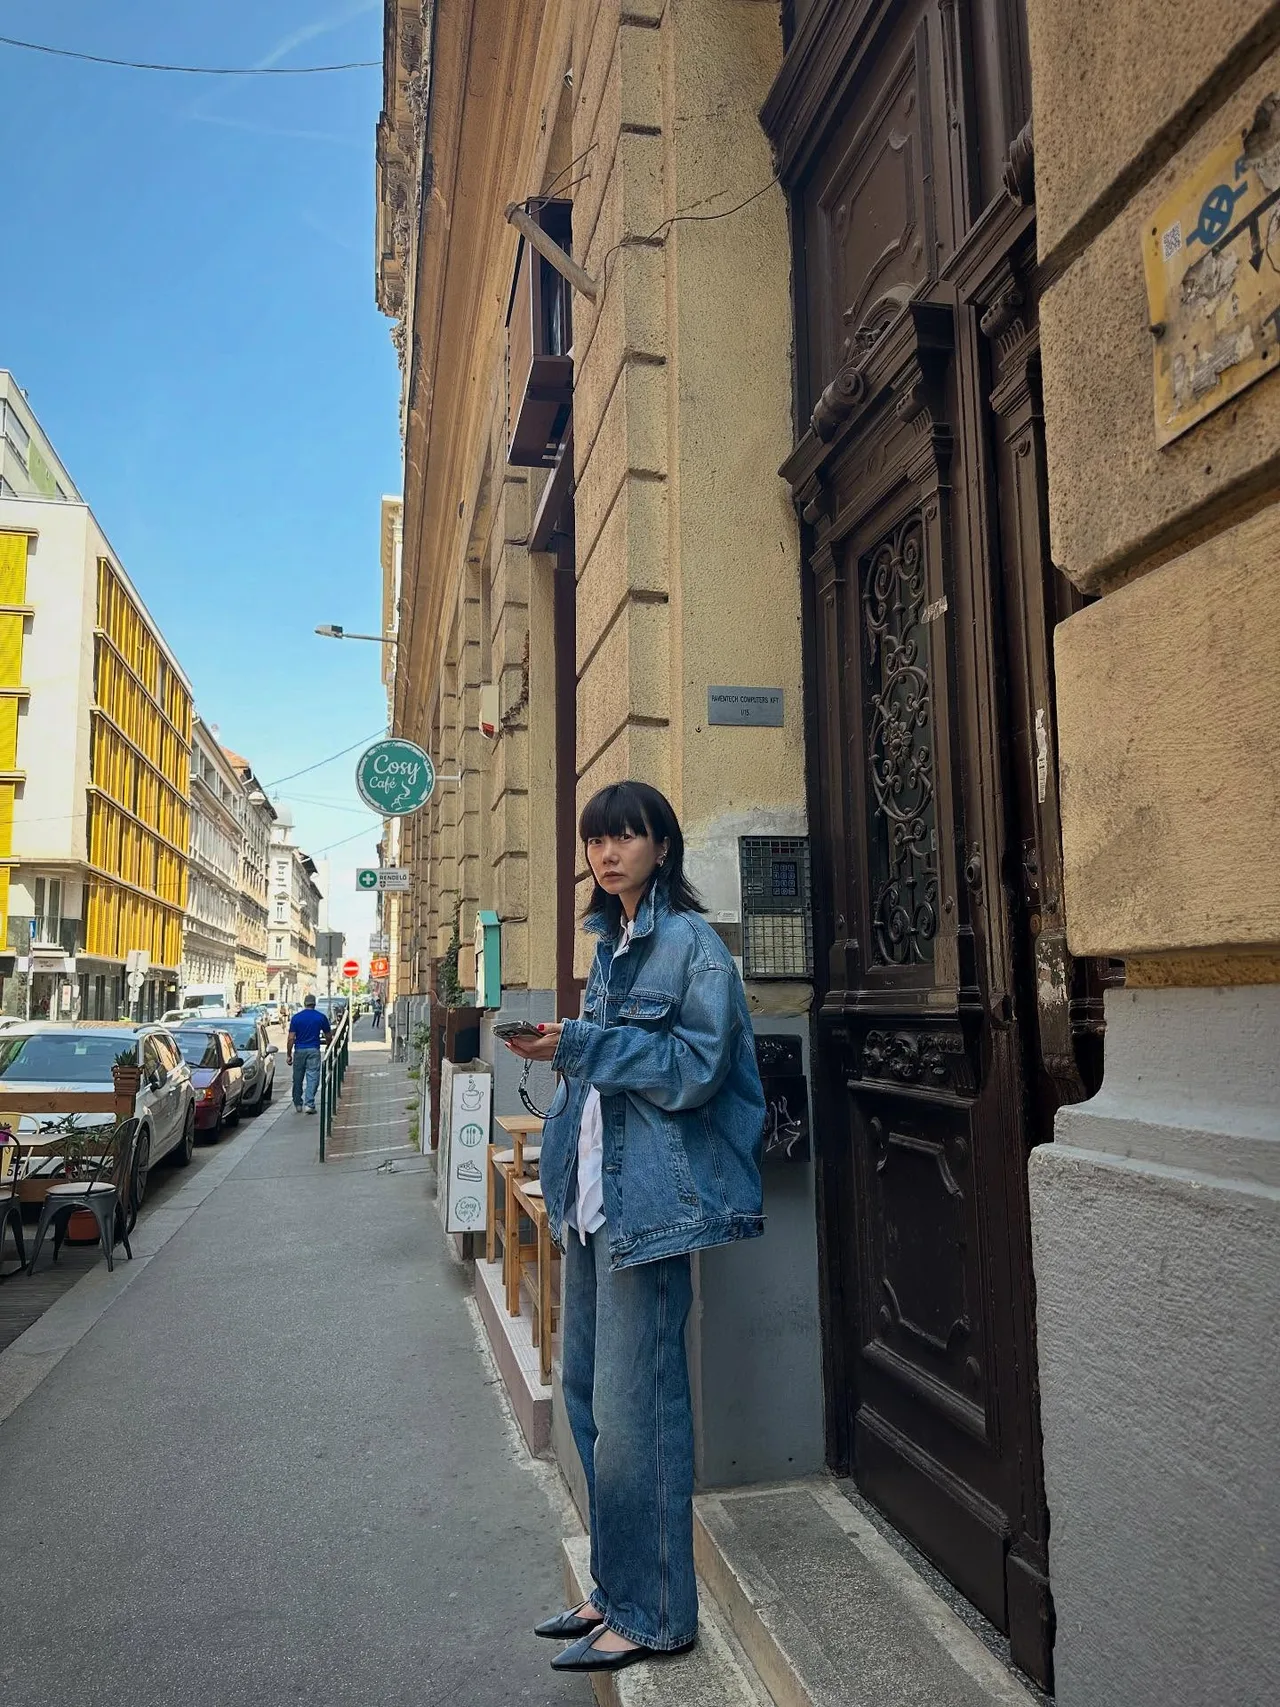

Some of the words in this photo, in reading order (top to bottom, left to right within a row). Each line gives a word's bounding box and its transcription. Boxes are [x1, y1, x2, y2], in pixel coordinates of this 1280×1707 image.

[740, 695, 769, 704] COMPUTERS
[374, 754, 421, 785] Cosy
[369, 776, 397, 795] Café
